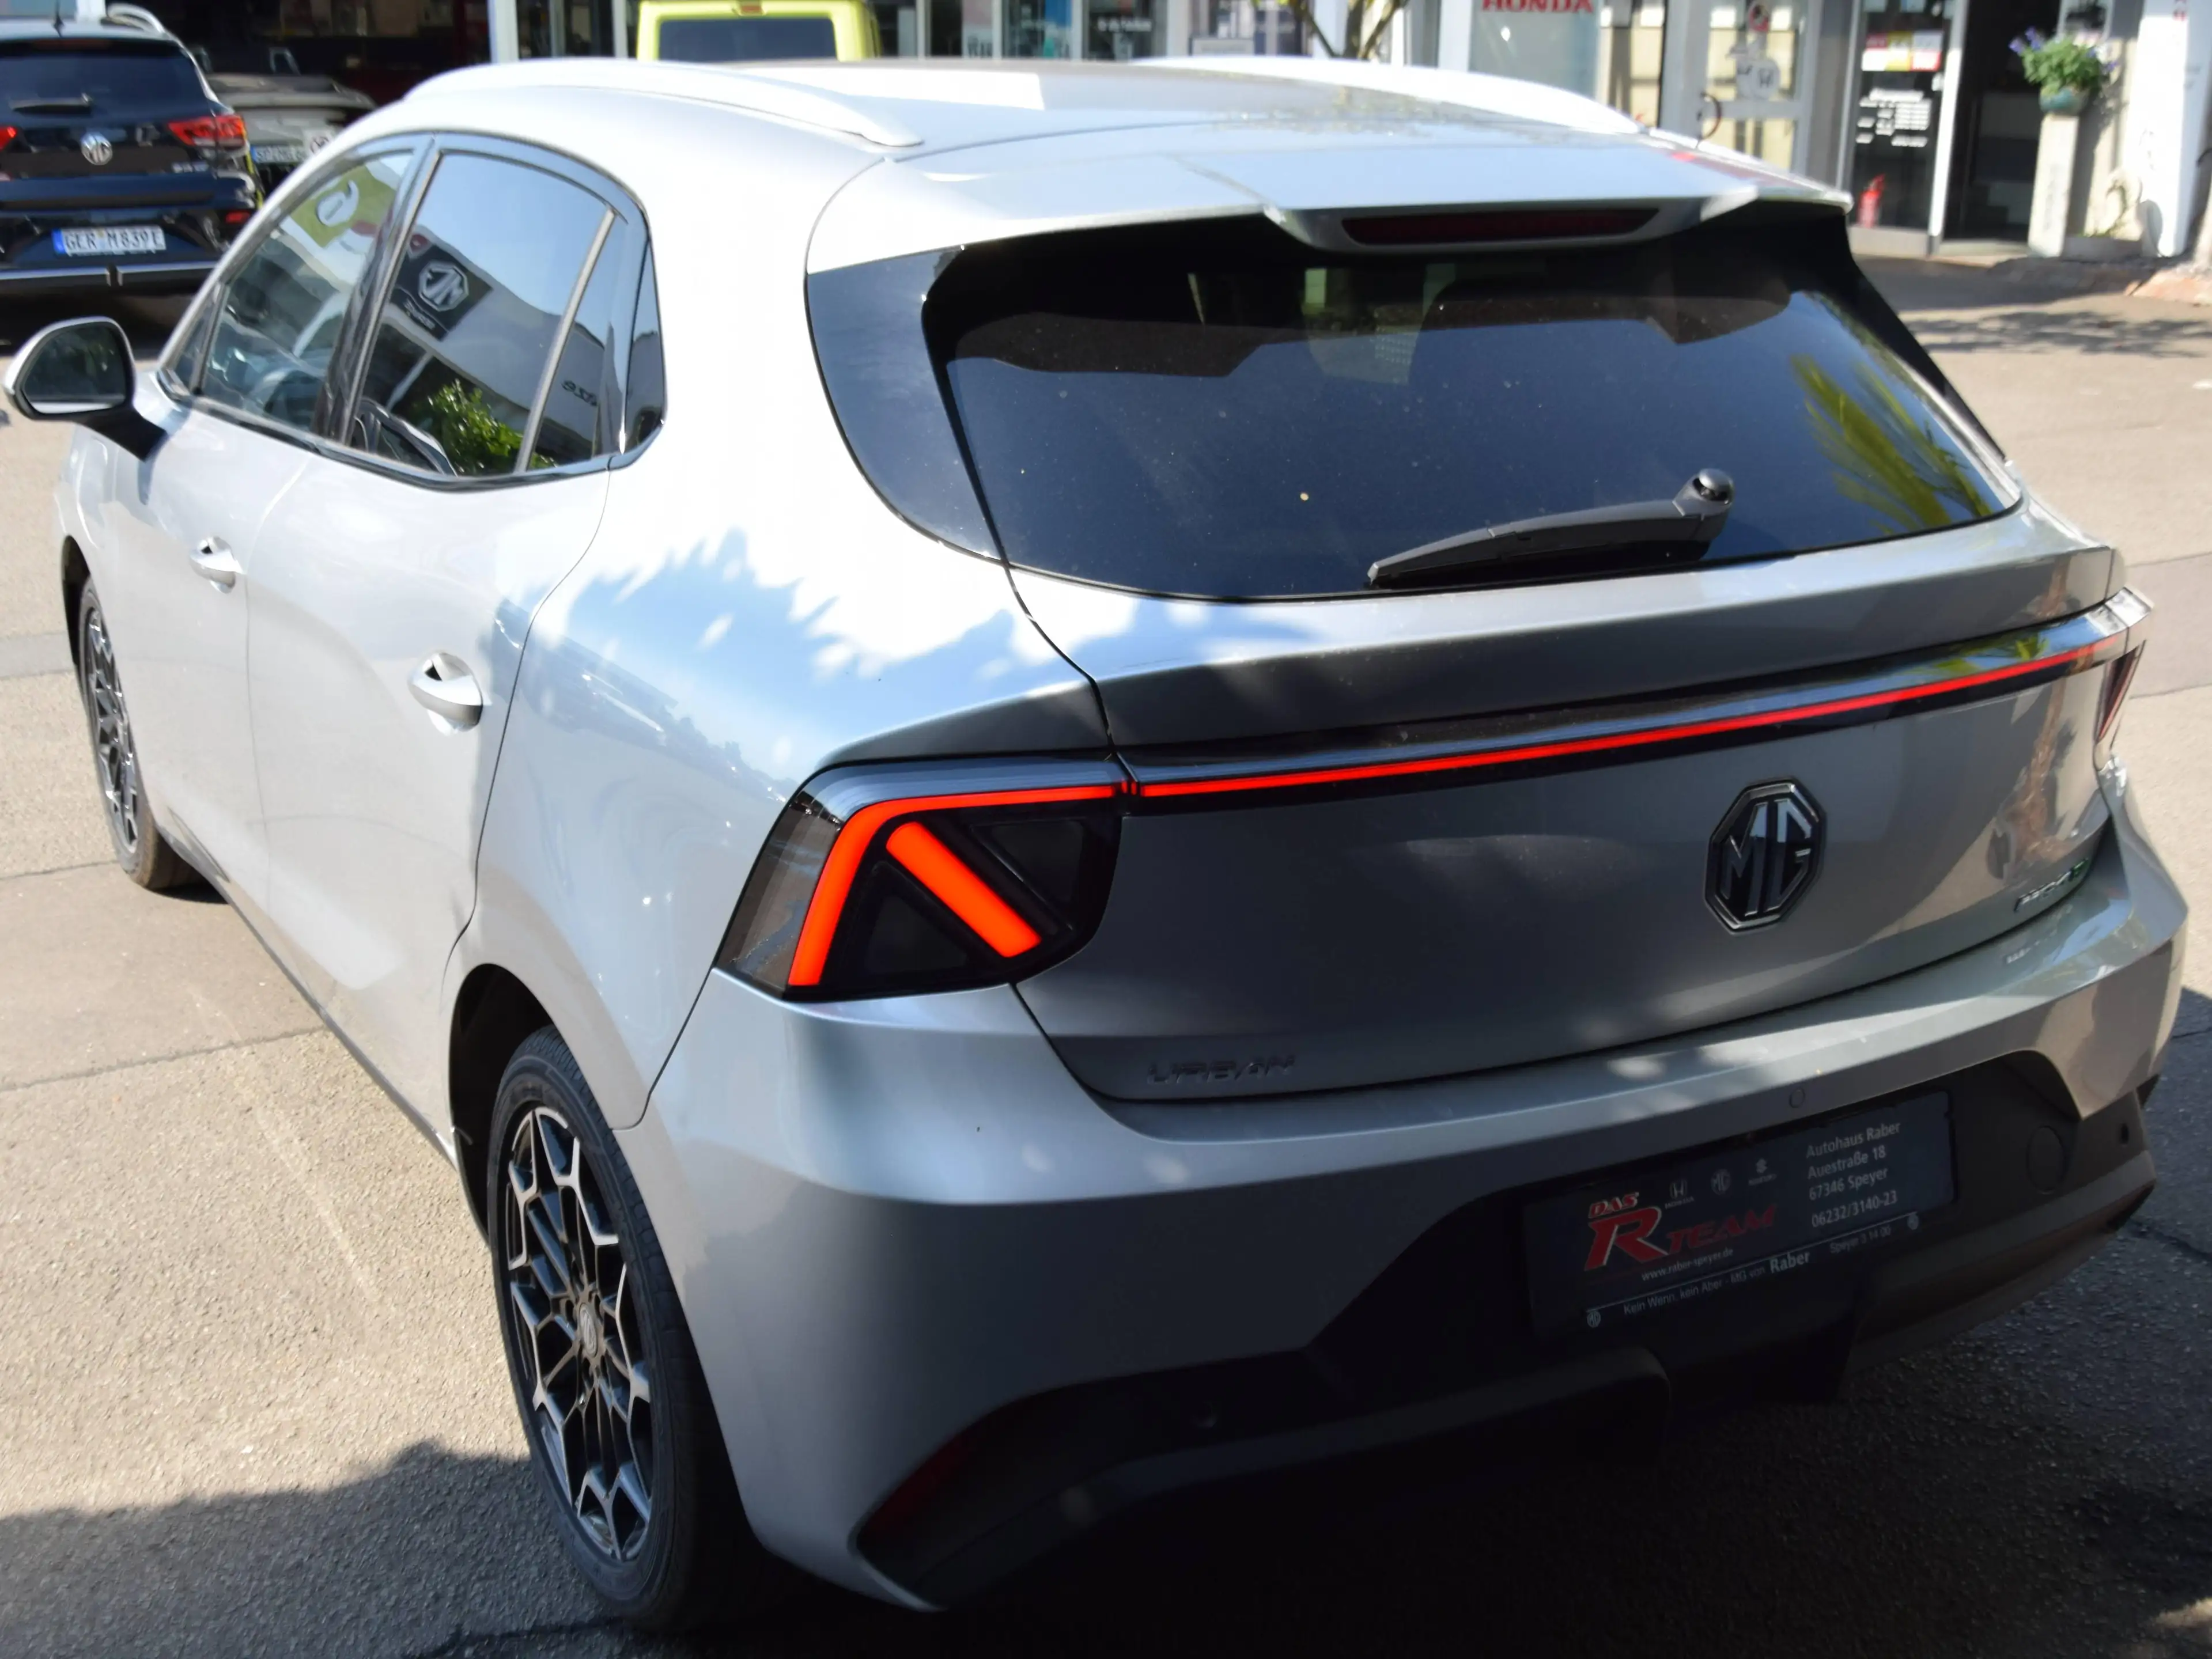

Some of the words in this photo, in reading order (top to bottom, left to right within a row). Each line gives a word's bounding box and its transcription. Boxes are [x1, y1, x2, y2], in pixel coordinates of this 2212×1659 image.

[1482, 0, 1593, 12] HONDA
[1714, 789, 1820, 923] MG
[1147, 1055, 1296, 1085] URBAN
[1806, 1132, 1864, 1159] Autohaus
[1866, 1123, 1900, 1141] Raber
[1808, 1150, 1868, 1179] Auestraße
[1872, 1145, 1886, 1160] 18
[1711, 1170, 1731, 1195] MG
[1809, 1178, 1845, 1200] 67346
[1848, 1168, 1888, 1191] Speyer
[1588, 1191, 1639, 1218] DAS
[1812, 1190, 1897, 1228] 06232/3140-23
[1584, 1206, 1669, 1271] R
[1666, 1203, 1777, 1255] TEAM
[1641, 1247, 1734, 1281] www.raber-speyer.de
[1623, 1301, 1646, 1315] Kein
[1679, 1285, 1699, 1300] kein
[1701, 1279, 1723, 1294] Aber
[1730, 1269, 1747, 1283] MG
[1749, 1266, 1765, 1278] von
[1769, 1251, 1810, 1274] Raber
